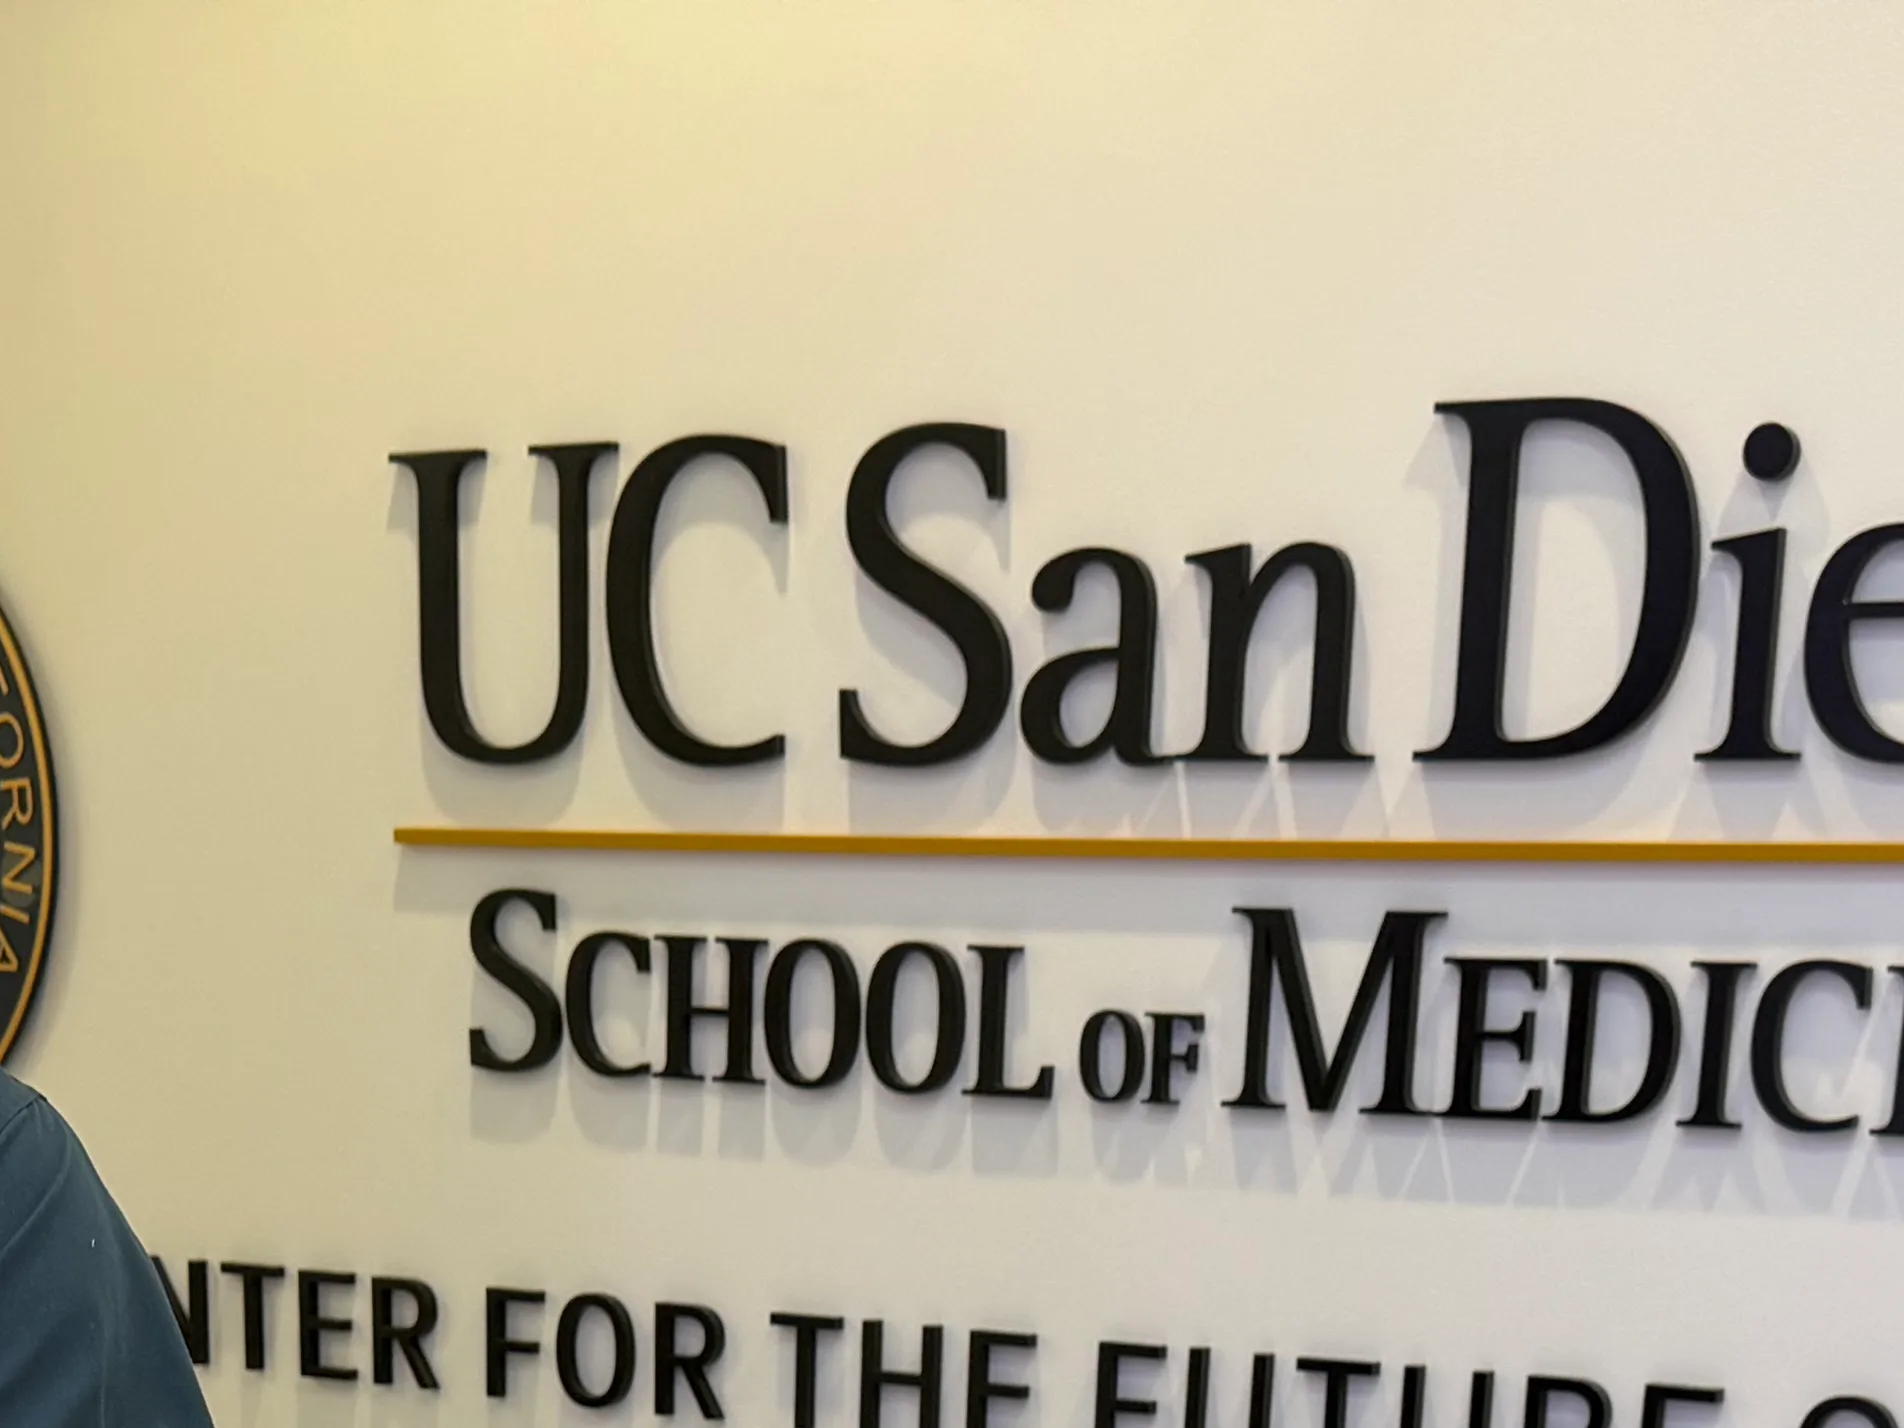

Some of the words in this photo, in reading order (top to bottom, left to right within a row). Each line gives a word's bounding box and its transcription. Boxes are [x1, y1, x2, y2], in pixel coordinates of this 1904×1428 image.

[387, 433, 790, 770] UC
[838, 421, 1376, 770] San
[468, 887, 1056, 1102] SCHOOL
[1078, 1009, 1206, 1107] OF
[149, 1254, 441, 1392] NTER
[484, 1286, 727, 1421] FOR
